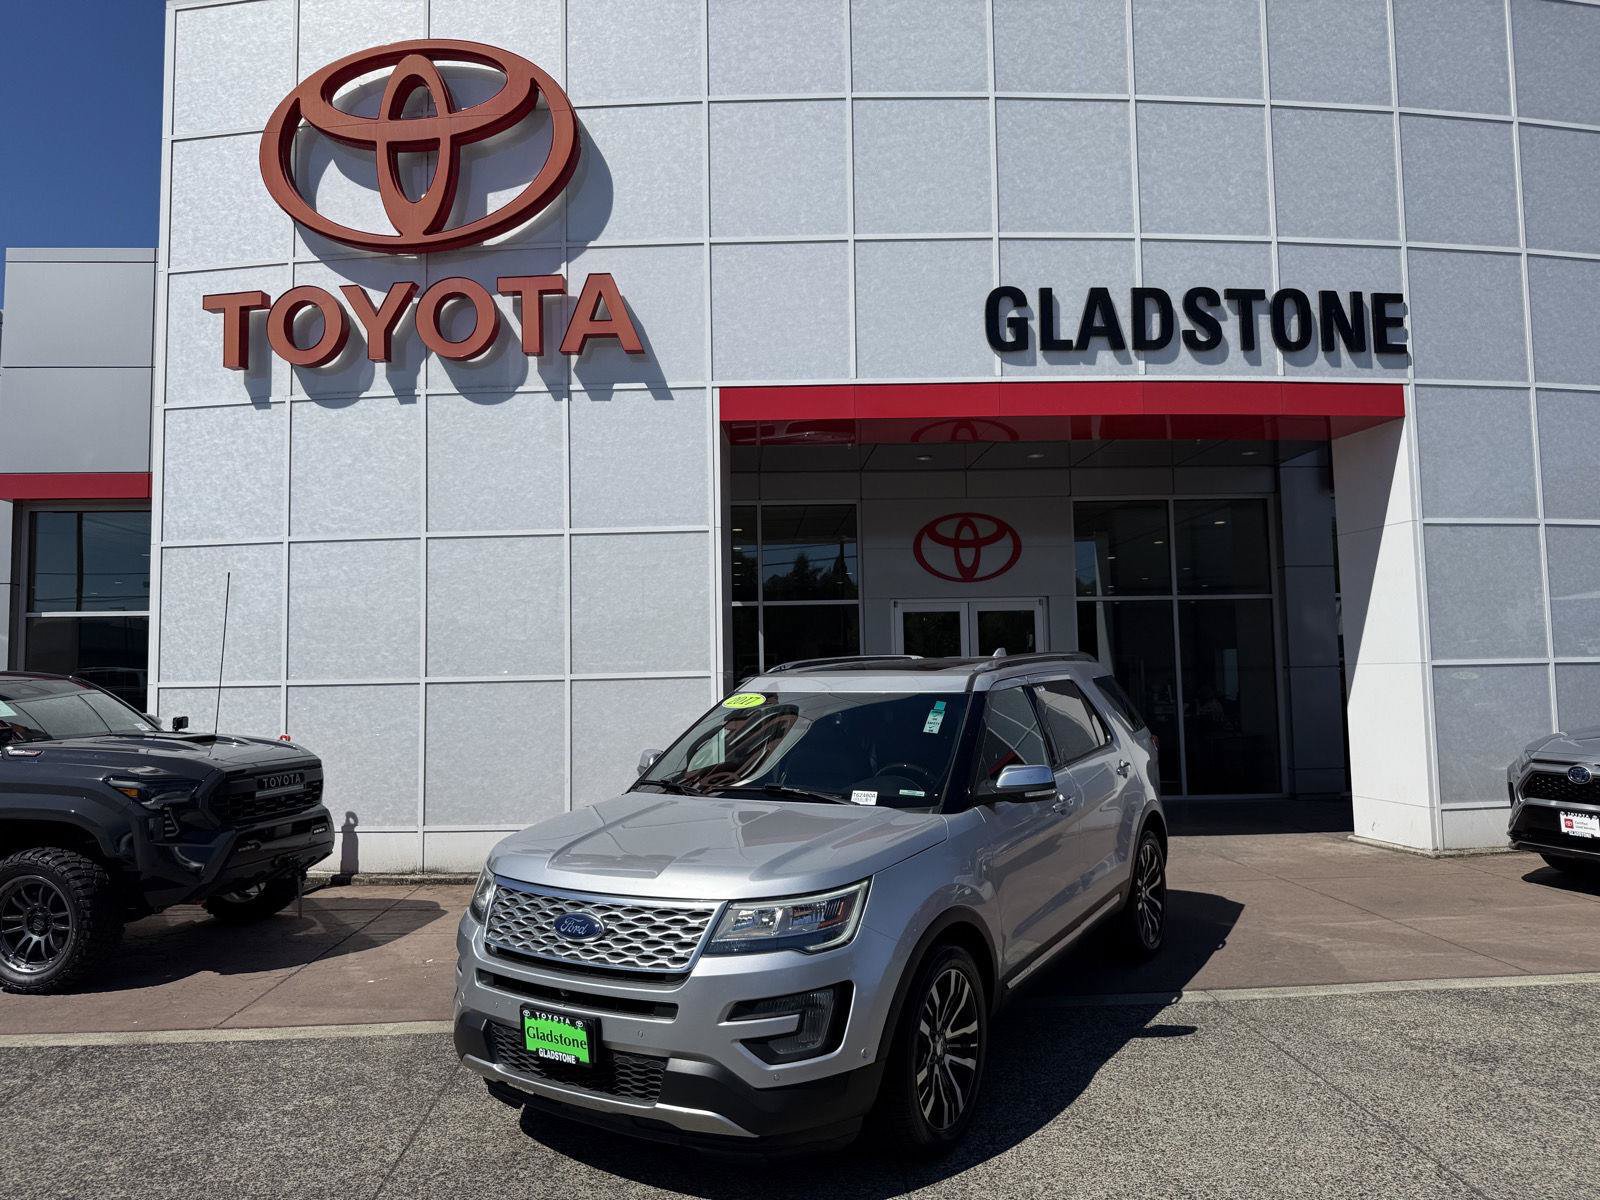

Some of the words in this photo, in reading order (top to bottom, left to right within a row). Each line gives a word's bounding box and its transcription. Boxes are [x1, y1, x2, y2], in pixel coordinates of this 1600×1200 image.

[202, 272, 645, 371] TOYOTA
[985, 286, 1410, 355] GLADSTONE
[726, 695, 761, 706] 2017
[262, 774, 301, 788] TOYOTA
[560, 917, 589, 935] Ford
[535, 1011, 571, 1025] TOYOTA
[526, 1025, 587, 1050] Gladstone
[538, 1048, 576, 1064] GLADSTONE
